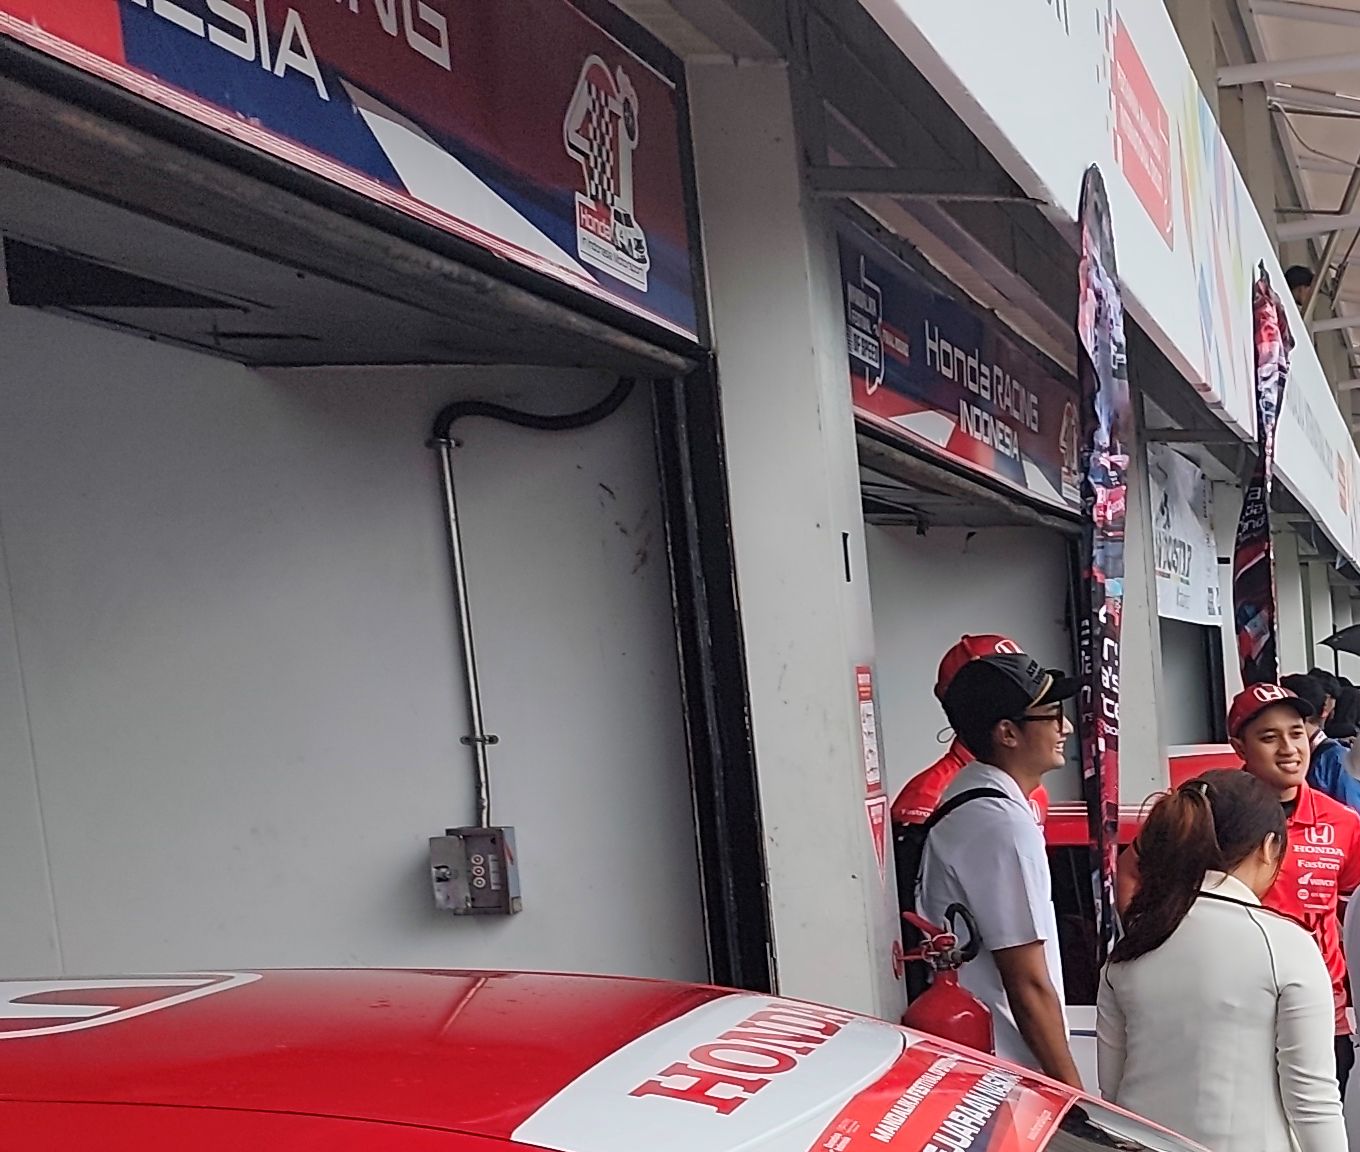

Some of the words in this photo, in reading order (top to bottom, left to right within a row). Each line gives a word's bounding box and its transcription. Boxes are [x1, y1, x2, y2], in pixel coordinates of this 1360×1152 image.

[924, 319, 991, 401] Honda
[993, 363, 1039, 432] RACING
[959, 399, 1019, 461] INDONESIA
[1292, 844, 1345, 857] HONDA
[1297, 859, 1341, 871] Fastron
[869, 1093, 920, 1144] MANDALIKA
